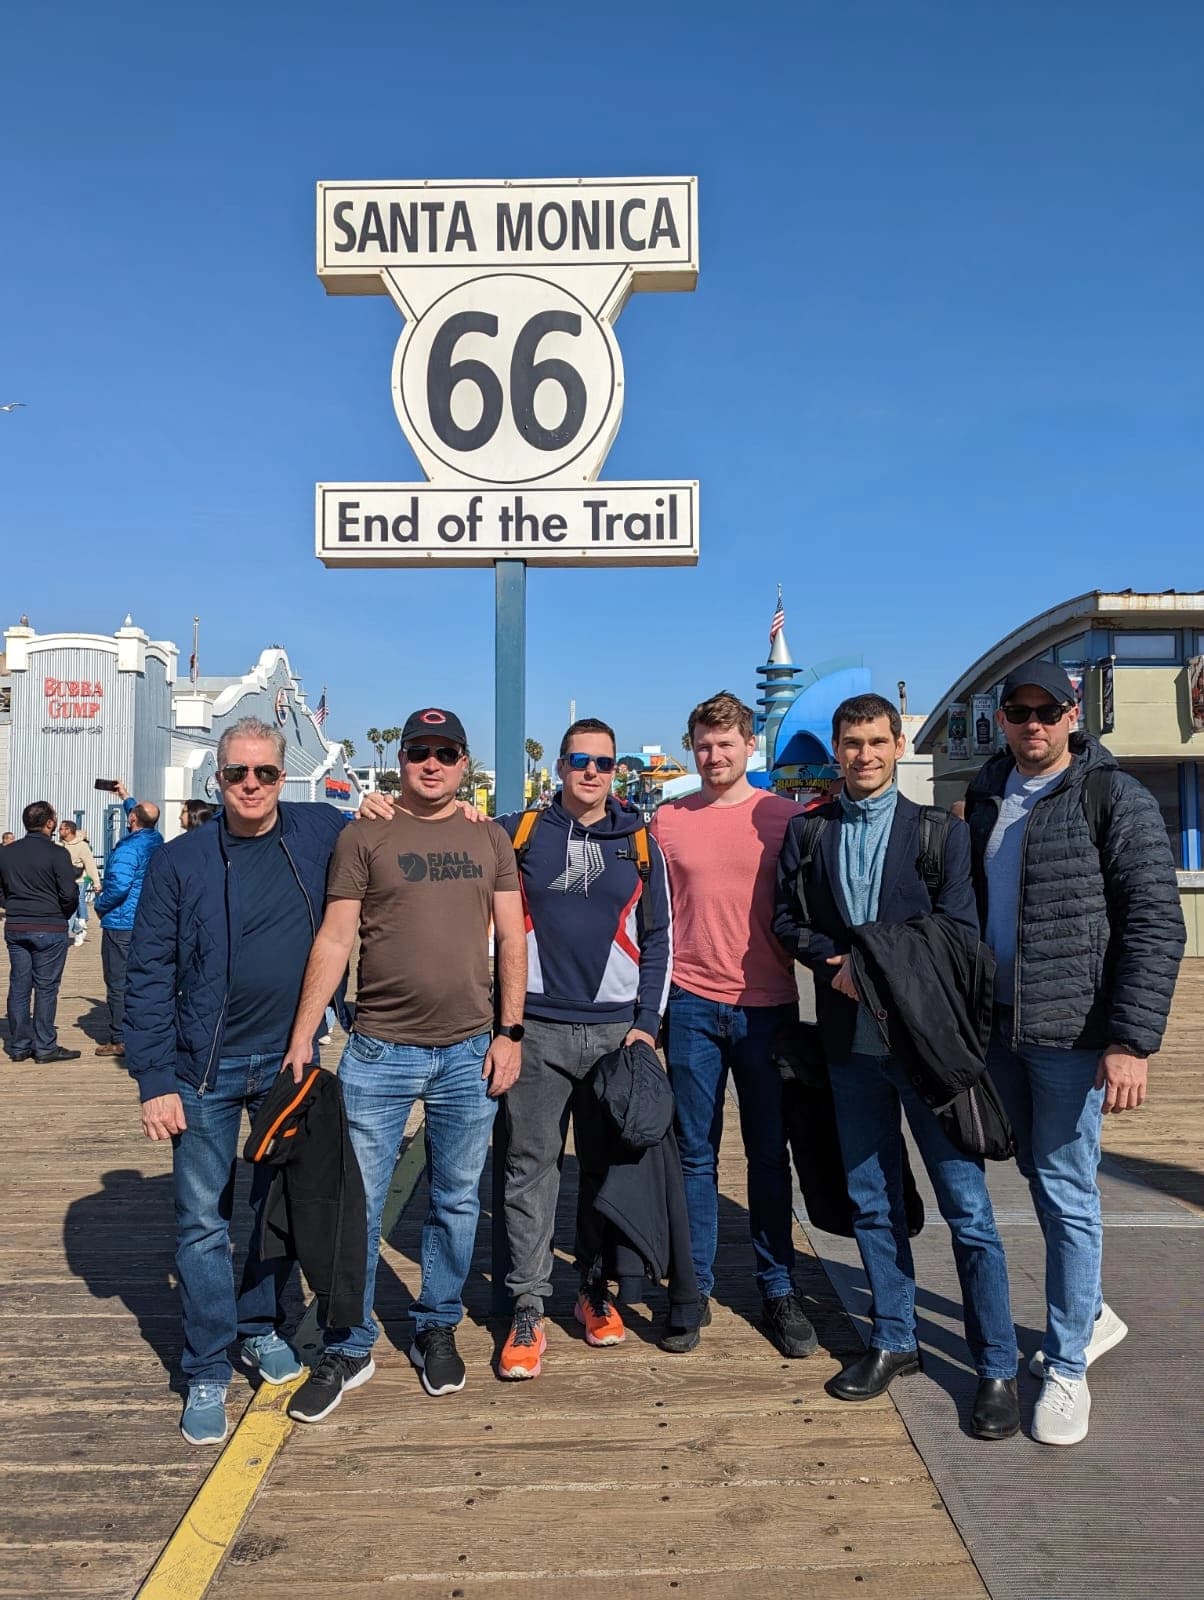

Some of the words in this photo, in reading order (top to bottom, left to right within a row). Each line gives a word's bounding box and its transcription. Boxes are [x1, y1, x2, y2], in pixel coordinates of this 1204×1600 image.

[334, 201, 476, 252] SANTA
[497, 198, 680, 251] MONICA
[427, 310, 587, 452] 66
[339, 497, 418, 542] End
[438, 496, 482, 542] of
[499, 496, 567, 542] the
[584, 495, 677, 540] Trail
[44, 677, 104, 697] BUBBA
[48, 700, 100, 719] GUMP
